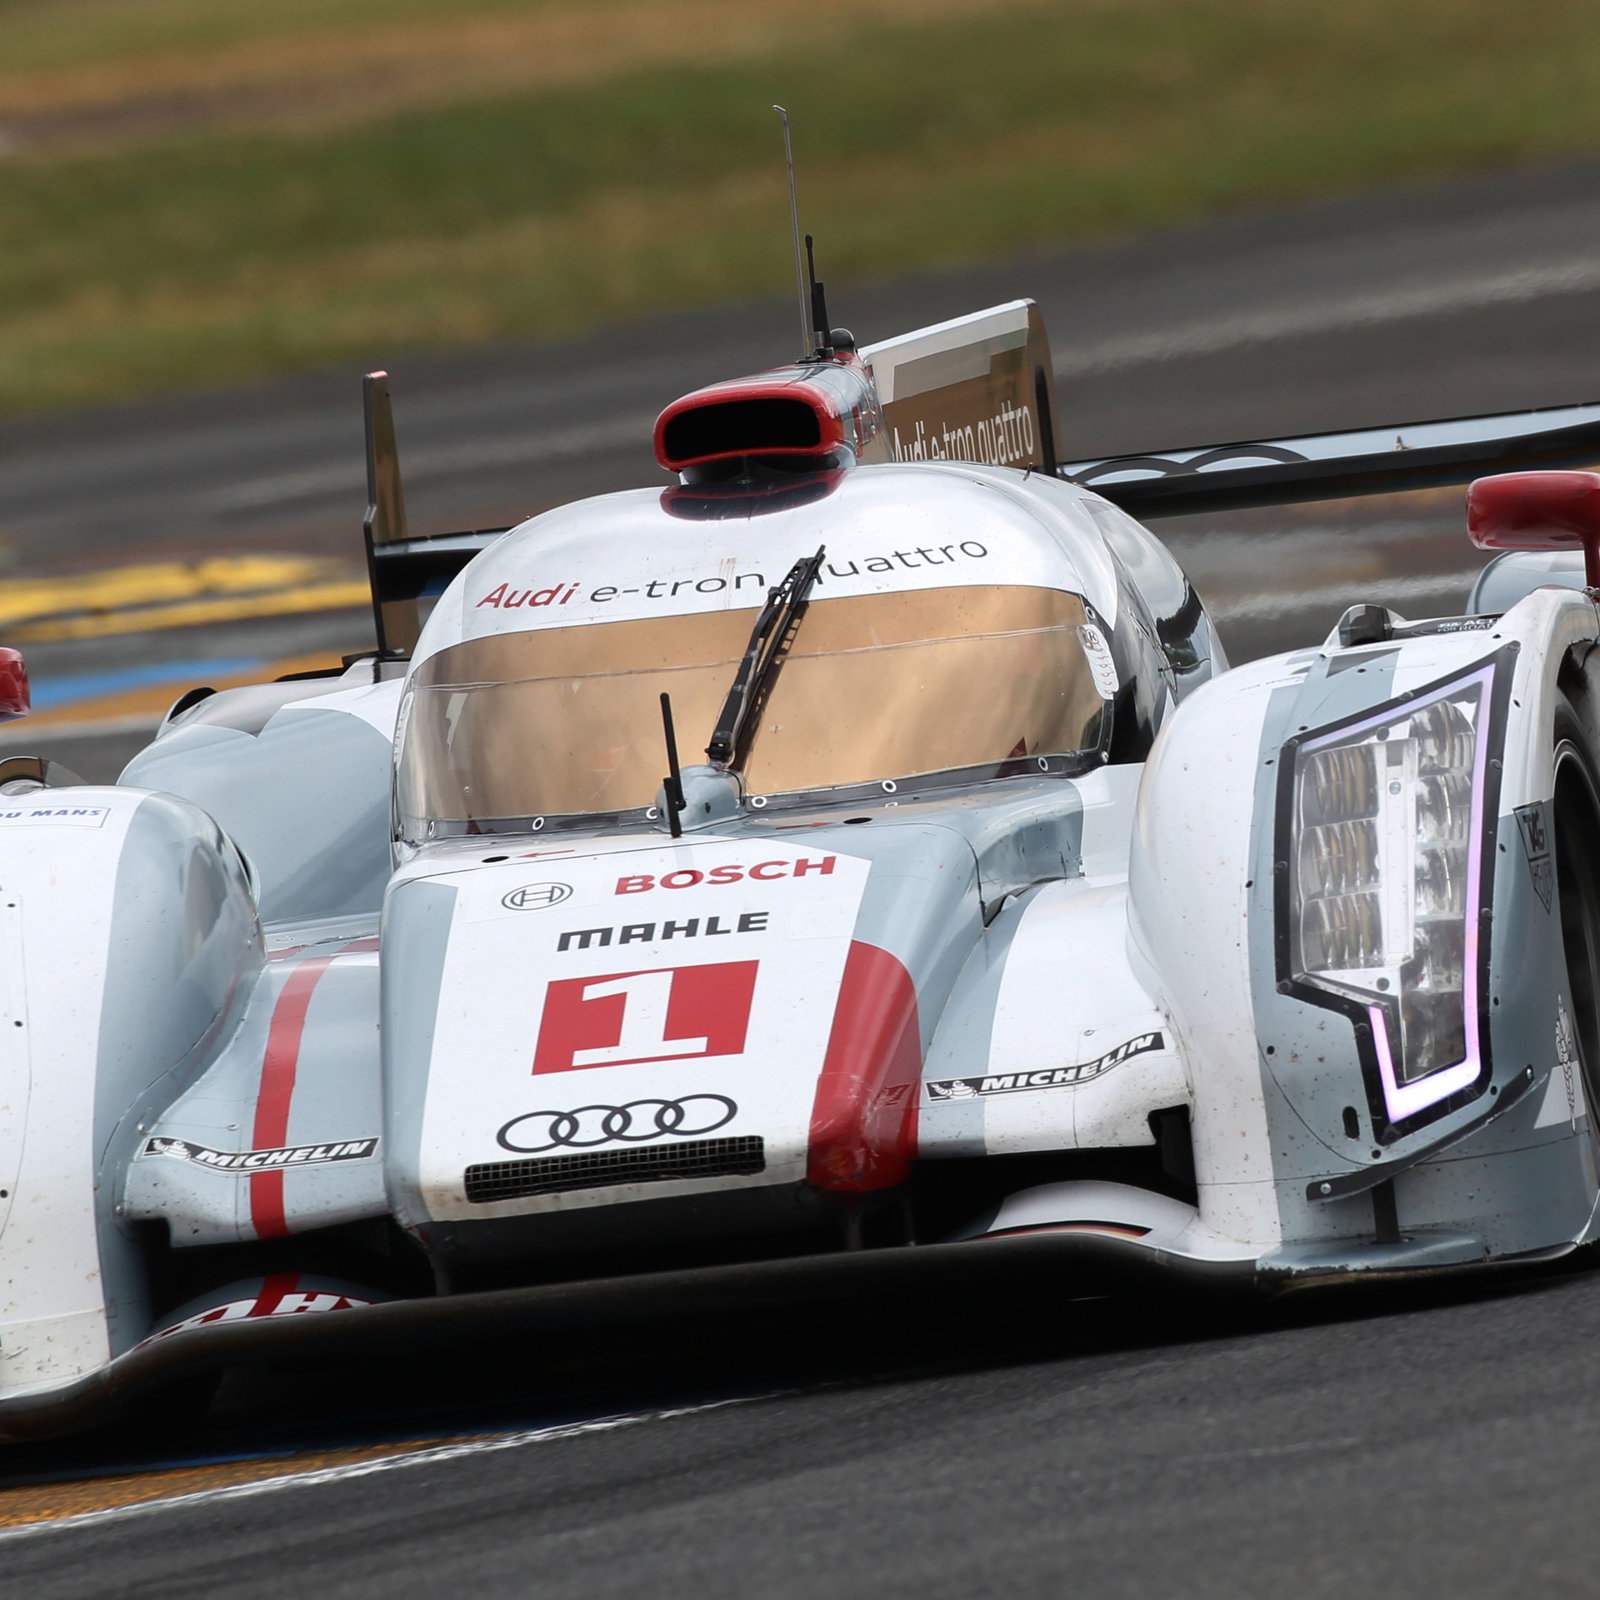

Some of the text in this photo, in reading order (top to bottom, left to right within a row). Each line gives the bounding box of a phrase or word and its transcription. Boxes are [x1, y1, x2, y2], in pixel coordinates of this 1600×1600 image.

[977, 400, 1034, 465] quattro
[476, 583, 580, 609] Audi
[589, 569, 765, 602] e-tron
[0, 809, 102, 819] U MANS
[614, 856, 837, 895] BOSCH
[557, 911, 770, 952] MAHLE
[571, 970, 709, 1067] 1
[981, 1034, 1155, 1091] MICHELIN
[196, 1141, 371, 1168] MICHELIN
